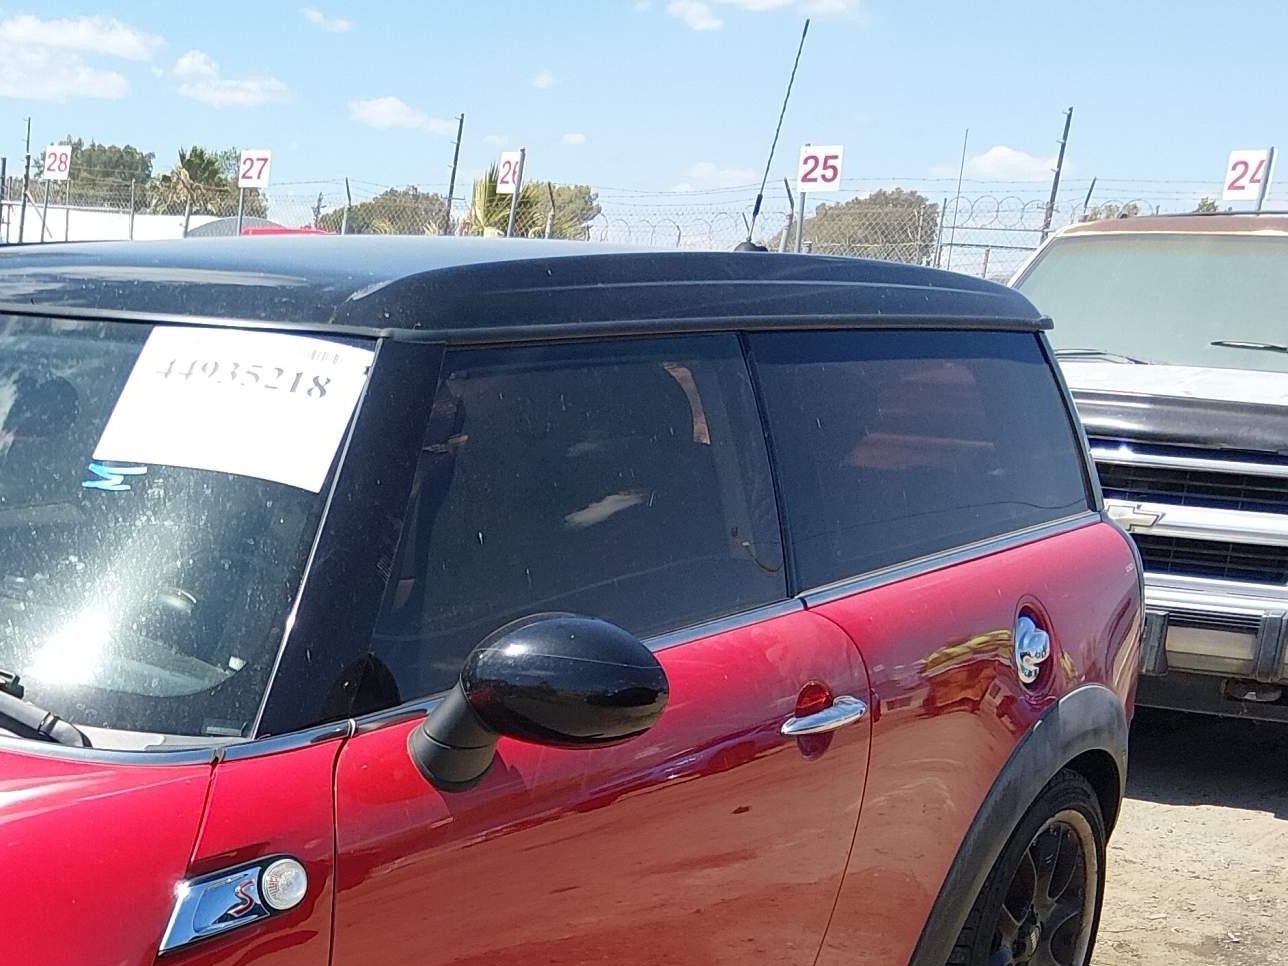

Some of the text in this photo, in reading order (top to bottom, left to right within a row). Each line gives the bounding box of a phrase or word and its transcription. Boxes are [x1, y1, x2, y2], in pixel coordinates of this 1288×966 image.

[46, 152, 68, 172] 28
[241, 157, 269, 180] 27
[801, 155, 839, 183] 25
[227, 879, 256, 917] S
